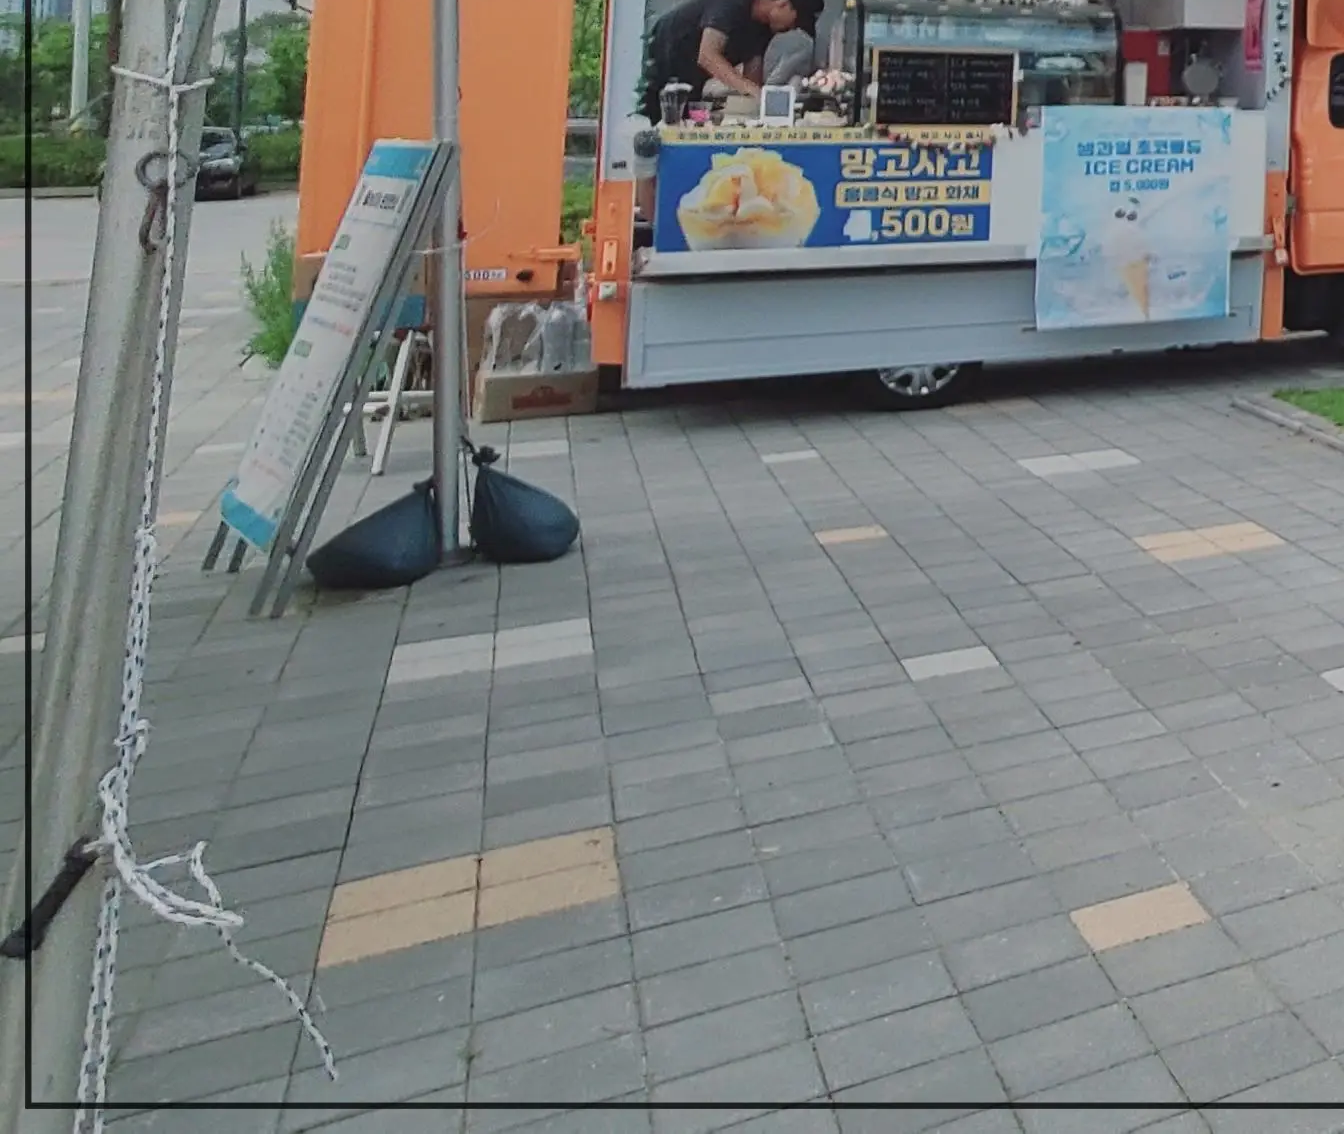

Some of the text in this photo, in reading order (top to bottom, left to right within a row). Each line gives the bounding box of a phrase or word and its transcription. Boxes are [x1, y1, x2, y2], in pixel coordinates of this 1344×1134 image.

[840, 147, 981, 179] 망고사고
[1084, 157, 1195, 176] ICE CREAM
[904, 185, 939, 202] 망고
[843, 207, 974, 242] ,500원
